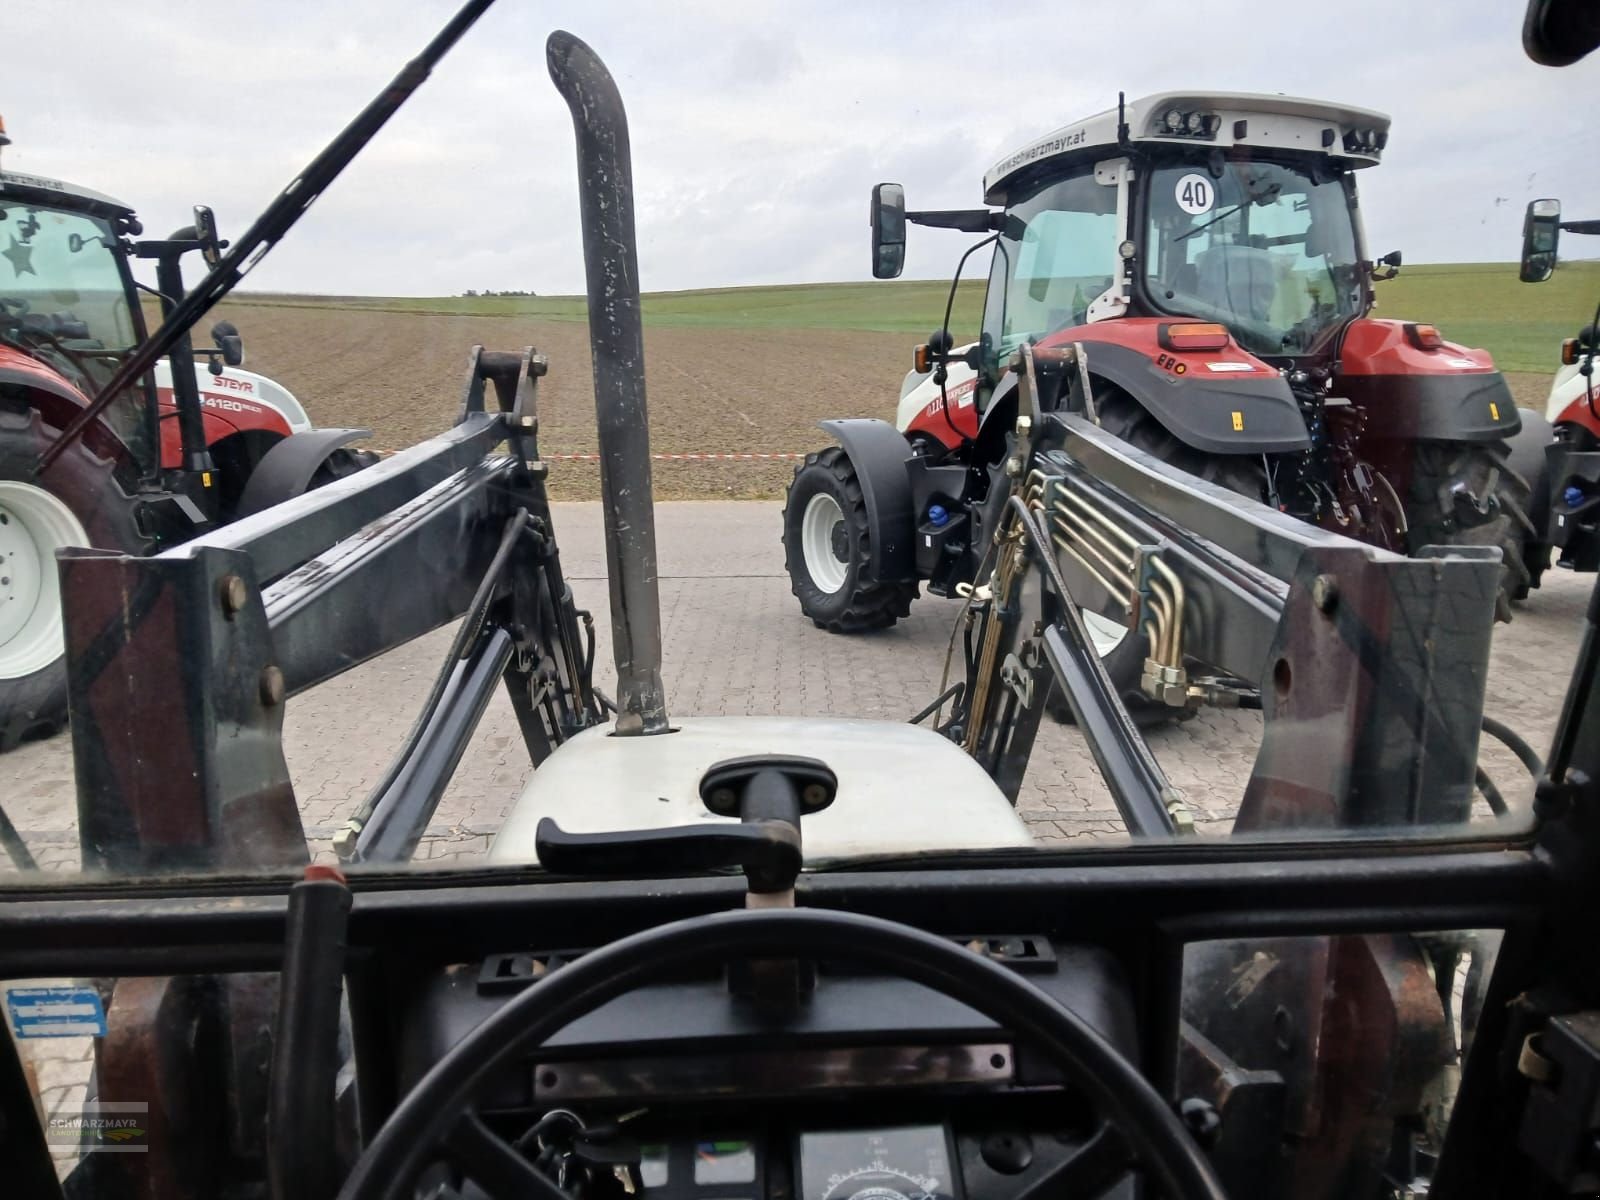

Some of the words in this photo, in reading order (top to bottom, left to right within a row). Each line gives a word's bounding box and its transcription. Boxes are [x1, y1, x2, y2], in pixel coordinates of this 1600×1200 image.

[1182, 181, 1206, 207] 40
[213, 376, 254, 393] STEYR
[206, 397, 242, 412] 4120
